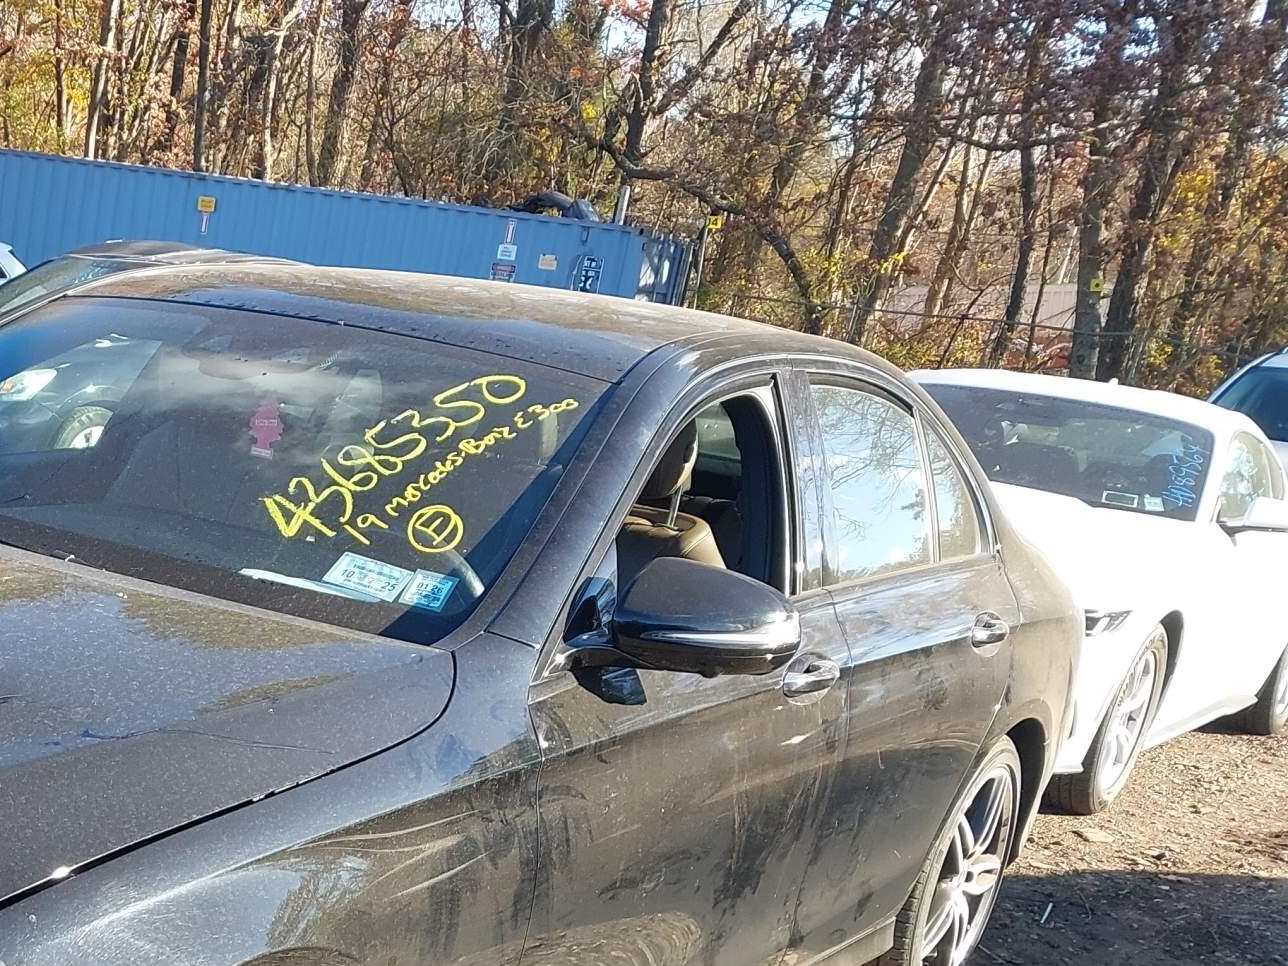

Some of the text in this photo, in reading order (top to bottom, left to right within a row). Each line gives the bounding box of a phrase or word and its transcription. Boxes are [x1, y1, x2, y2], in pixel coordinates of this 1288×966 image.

[259, 375, 526, 538] 43685350
[343, 514, 389, 544] 19
[341, 569, 355, 578] 10
[381, 581, 399, 592] 25
